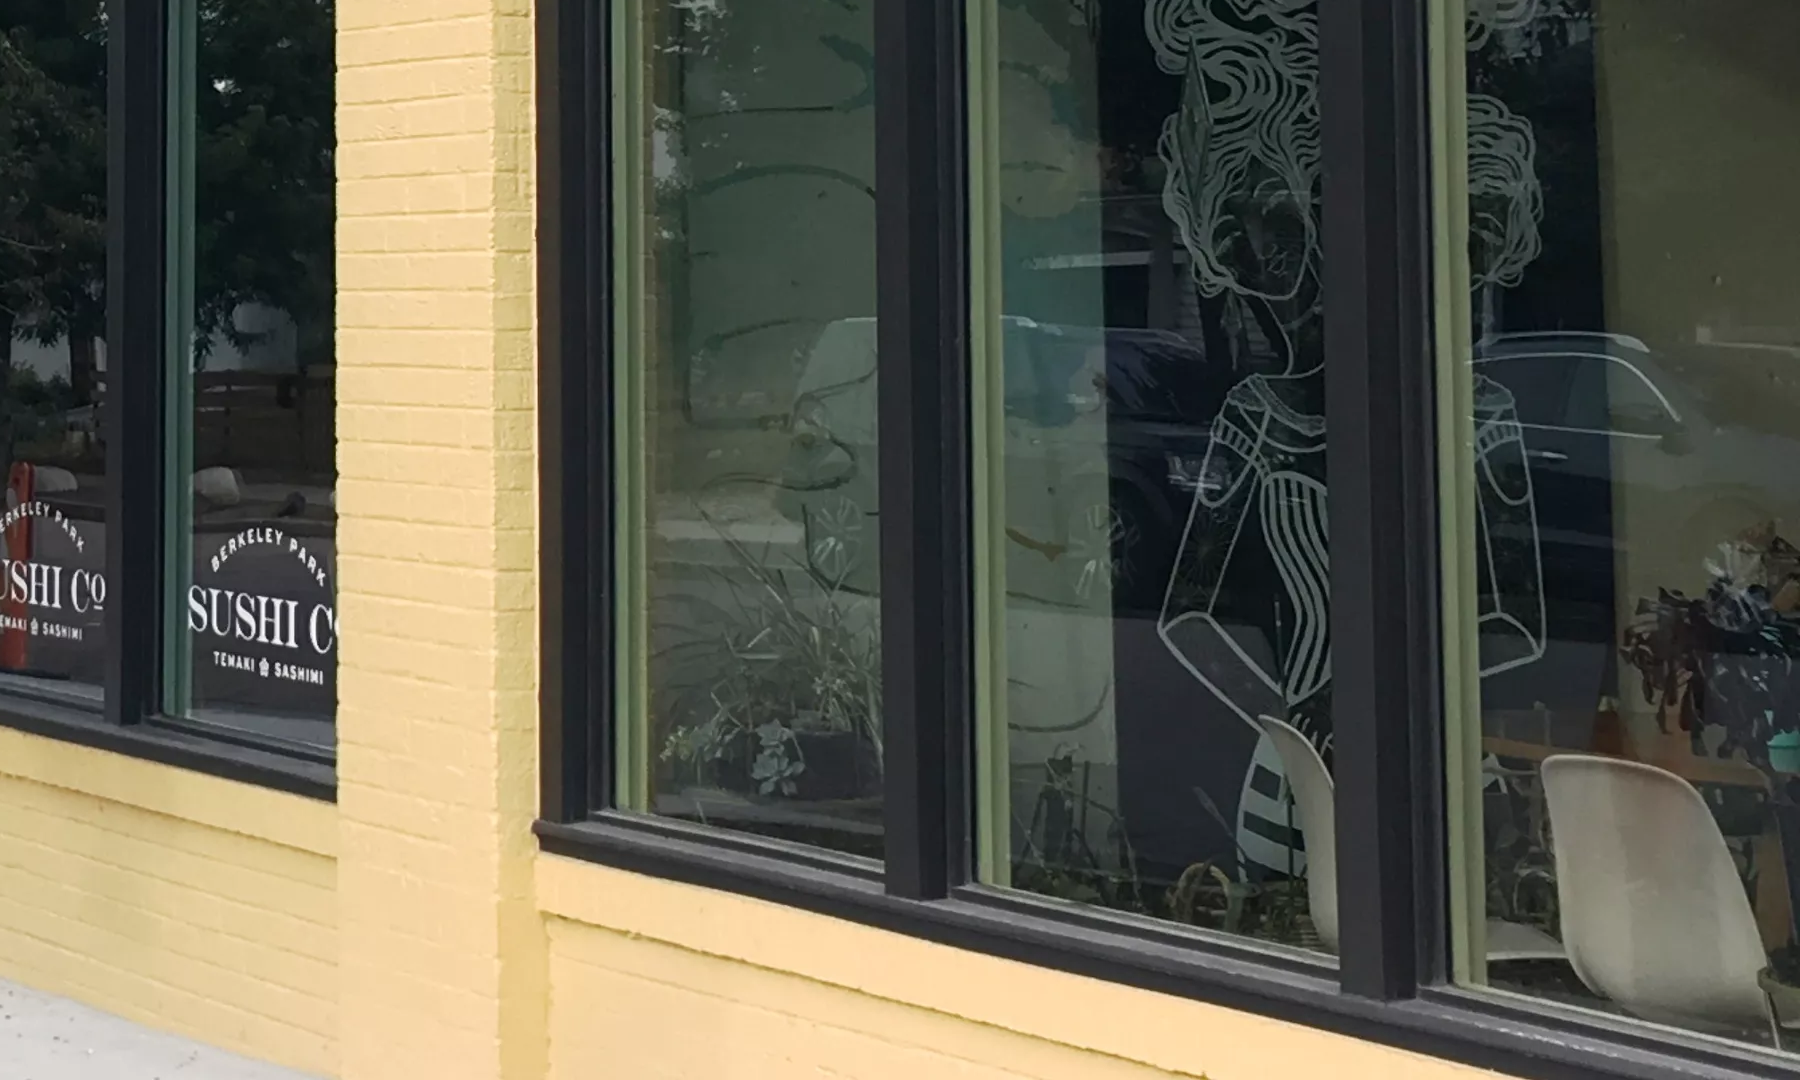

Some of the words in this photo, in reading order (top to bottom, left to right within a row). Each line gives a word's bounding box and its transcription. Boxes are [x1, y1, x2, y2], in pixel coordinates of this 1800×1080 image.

[55, 510, 85, 554] PARK
[210, 527, 284, 573] BERKELEY
[289, 537, 326, 588] PARK
[42, 622, 83, 641] SASHIMI
[187, 584, 300, 650] SUSHI
[213, 650, 255, 673] TEMAKI
[274, 661, 325, 686] SASHIMI
